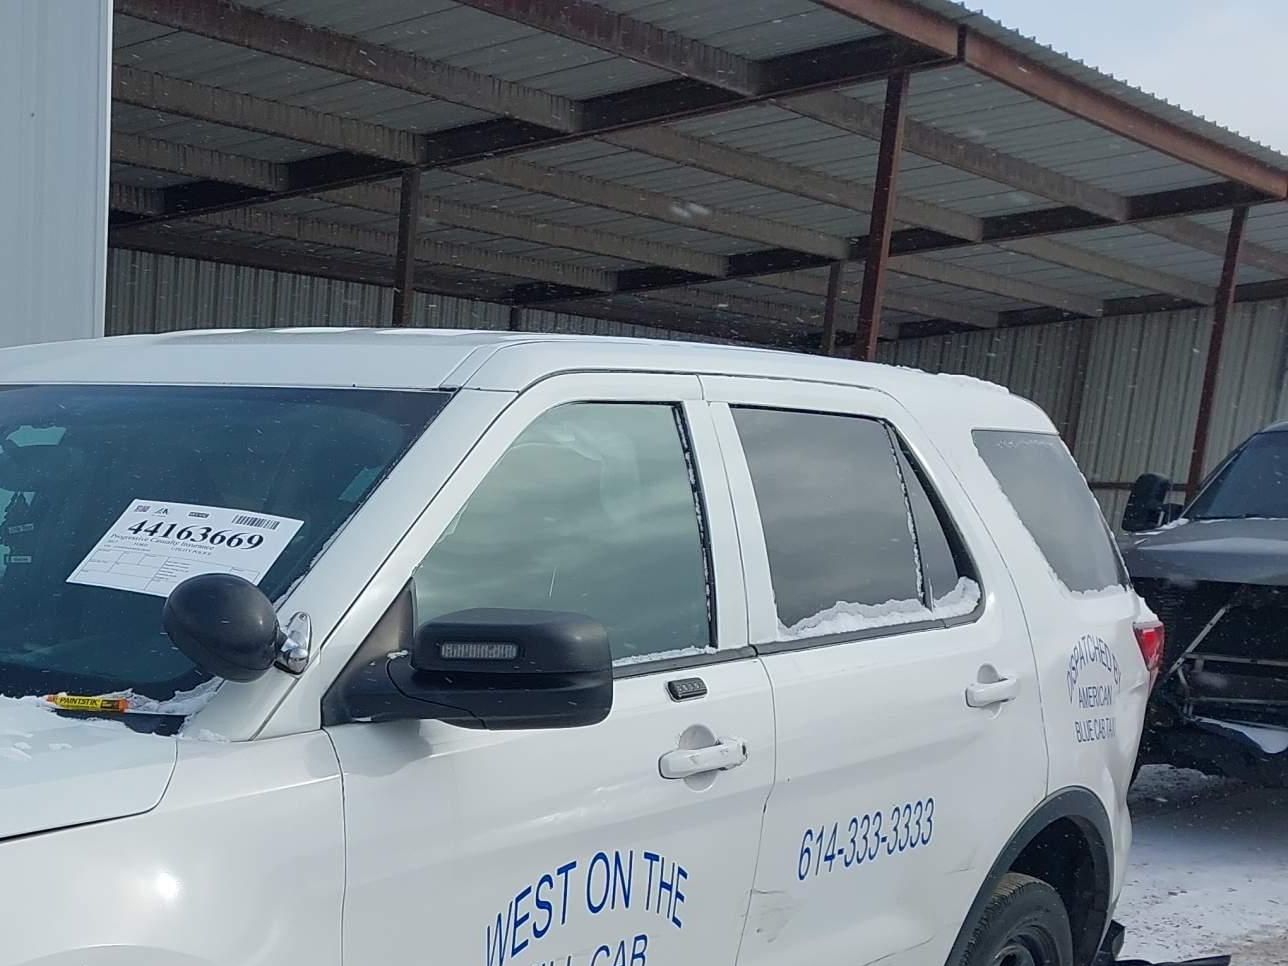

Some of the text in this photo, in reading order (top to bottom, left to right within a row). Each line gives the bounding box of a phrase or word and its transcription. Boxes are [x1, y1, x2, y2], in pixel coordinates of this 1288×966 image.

[127, 519, 264, 550] 44163669
[1077, 684, 1113, 709] AMERICAN
[1074, 719, 1095, 743] BLUE
[798, 797, 934, 880] 614-333-3333
[586, 850, 633, 914] ON
[643, 851, 688, 928] THE
